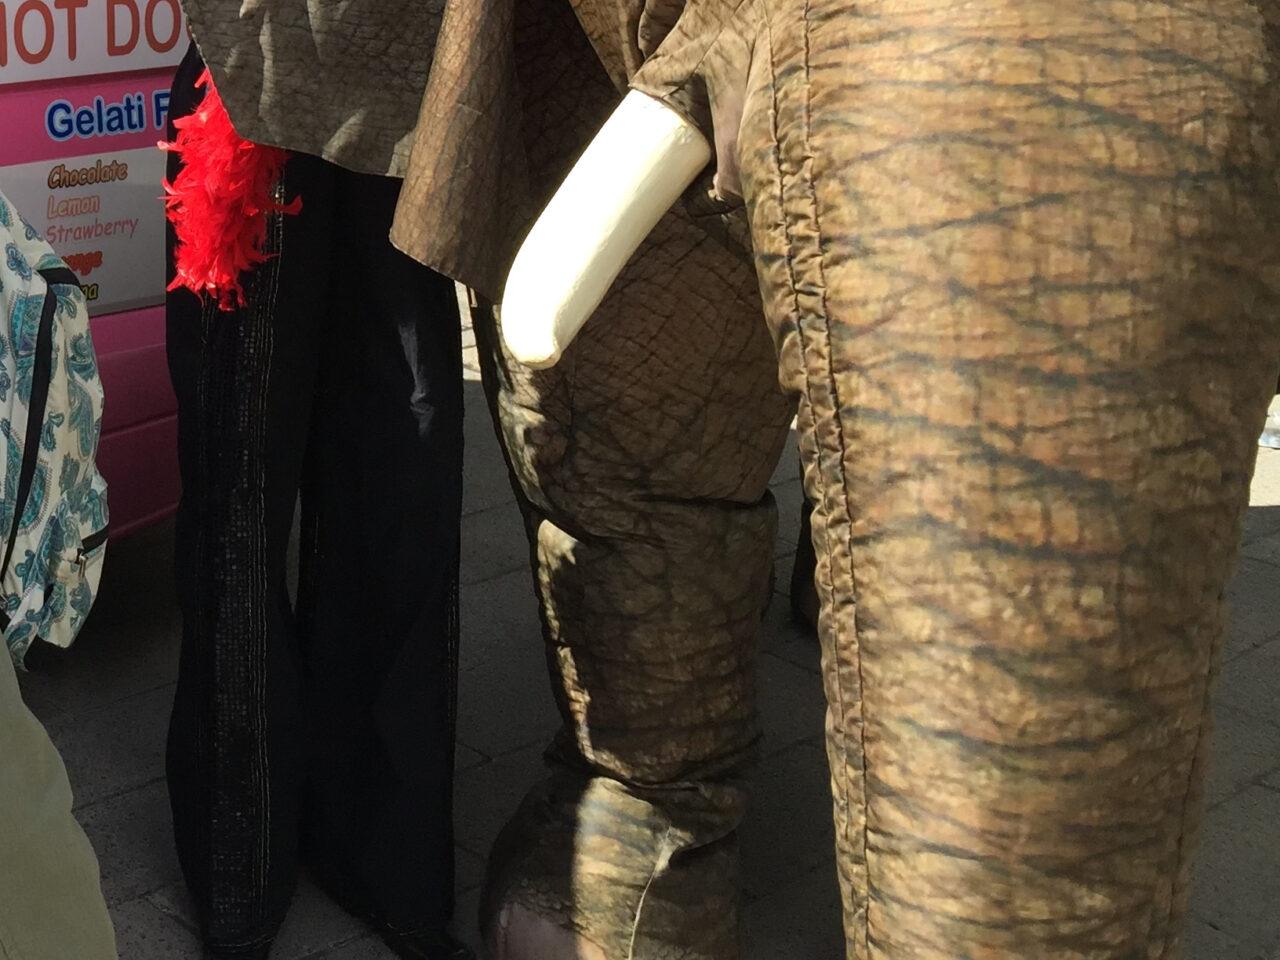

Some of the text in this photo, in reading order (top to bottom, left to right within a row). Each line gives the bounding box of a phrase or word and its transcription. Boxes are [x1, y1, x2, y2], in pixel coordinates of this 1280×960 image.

[46, 93, 146, 140] Gelati
[47, 159, 129, 190] Chocolate
[47, 194, 100, 219] Lemon
[45, 217, 139, 243] Strawberry
